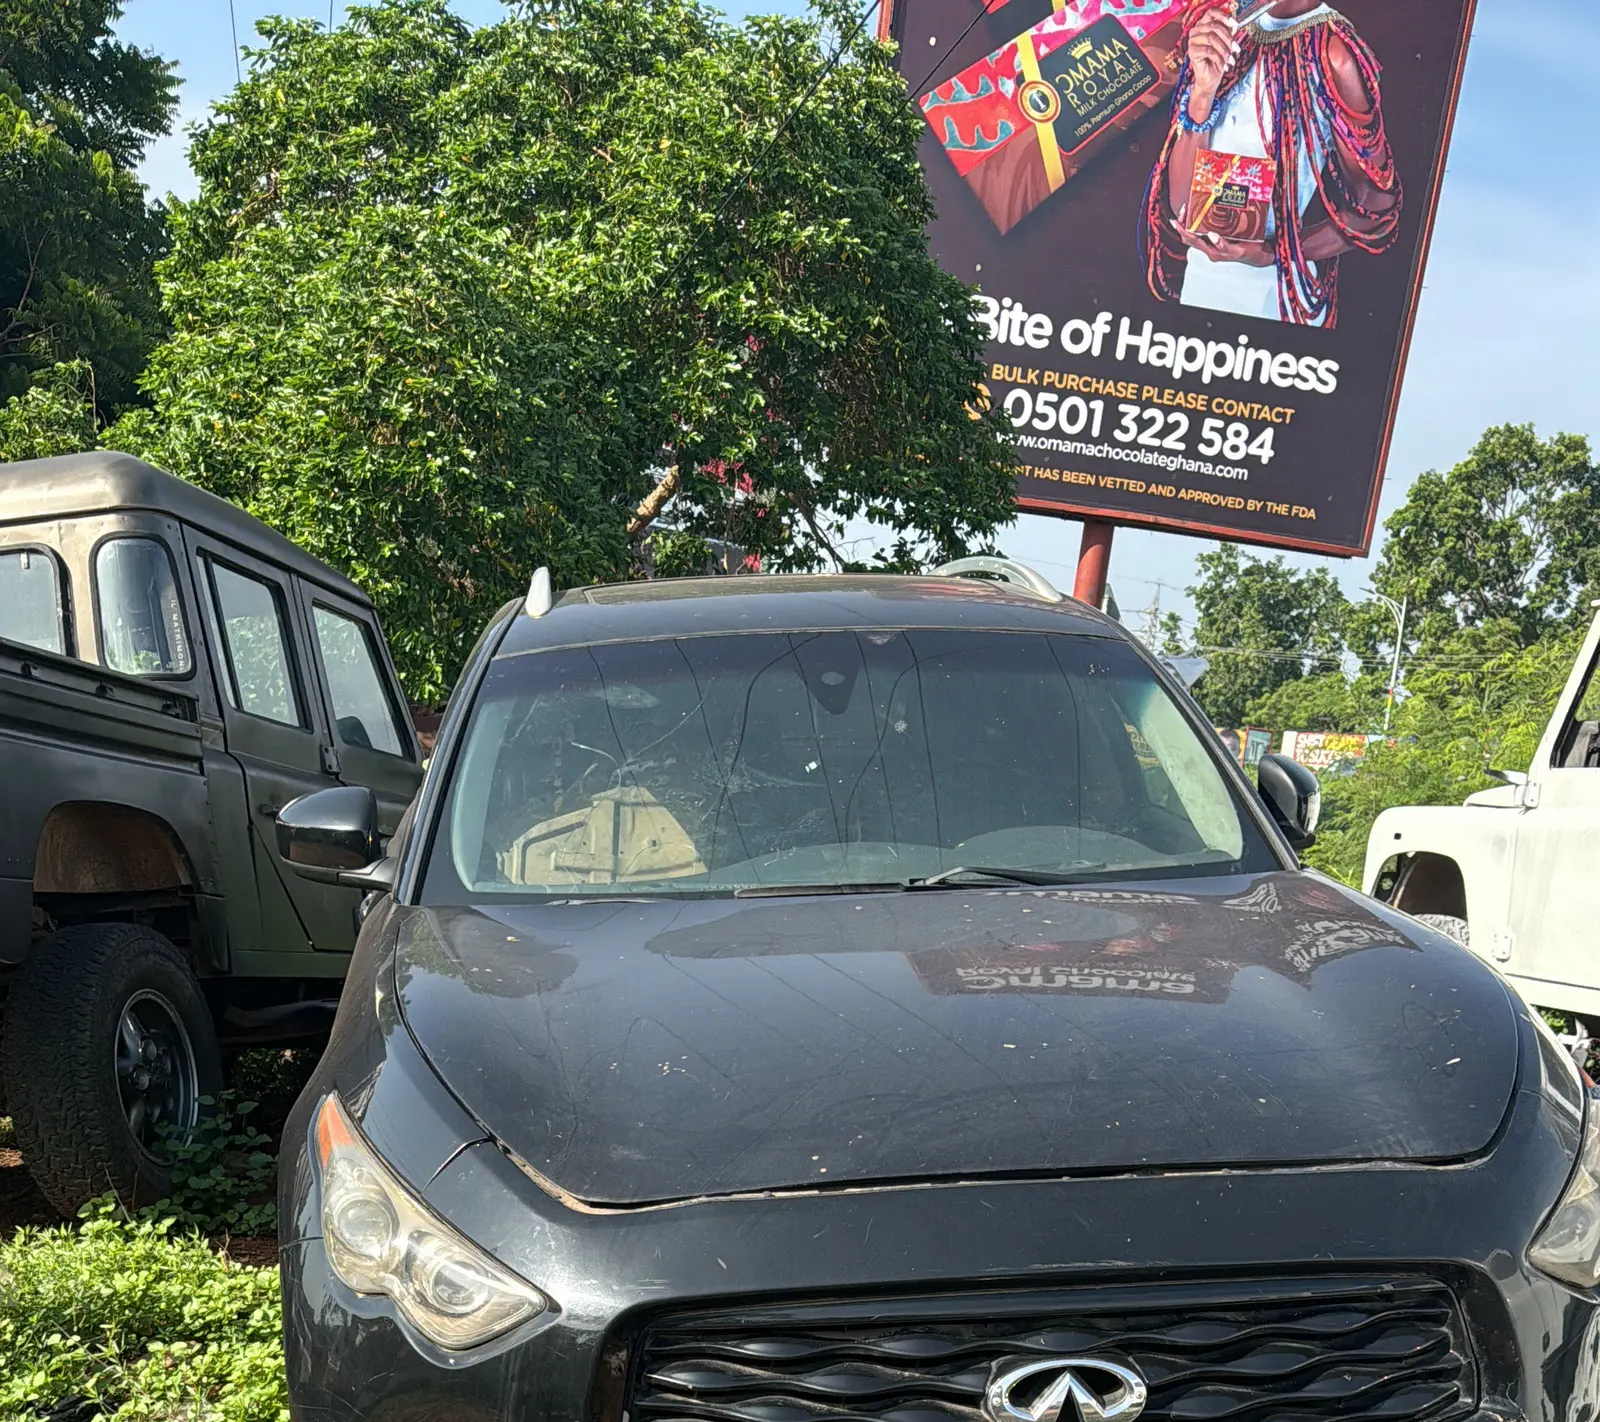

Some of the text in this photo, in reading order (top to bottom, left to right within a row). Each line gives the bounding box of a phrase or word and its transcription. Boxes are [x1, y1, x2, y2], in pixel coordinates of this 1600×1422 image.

[1067, 51, 1138, 109] ROYAL
[1074, 75, 1152, 138] 100% Premium Ghana Cocoa
[1076, 62, 1144, 117] MILK CHOCOLATE
[967, 294, 1340, 394] Bite of Happiness
[991, 363, 1295, 424] BULK PURCHASE PLEASE CONTACT
[1003, 388, 1275, 465] 0501 322 584
[1033, 467, 1060, 482] HAS
[1061, 471, 1096, 486] BEEN
[1098, 476, 1147, 493] VETTED
[1147, 483, 1176, 498] AND
[1178, 488, 1245, 510] APPROVED
[1246, 499, 1264, 512] BY
[1265, 501, 1289, 516] THE
[1290, 505, 1317, 520] FDA
